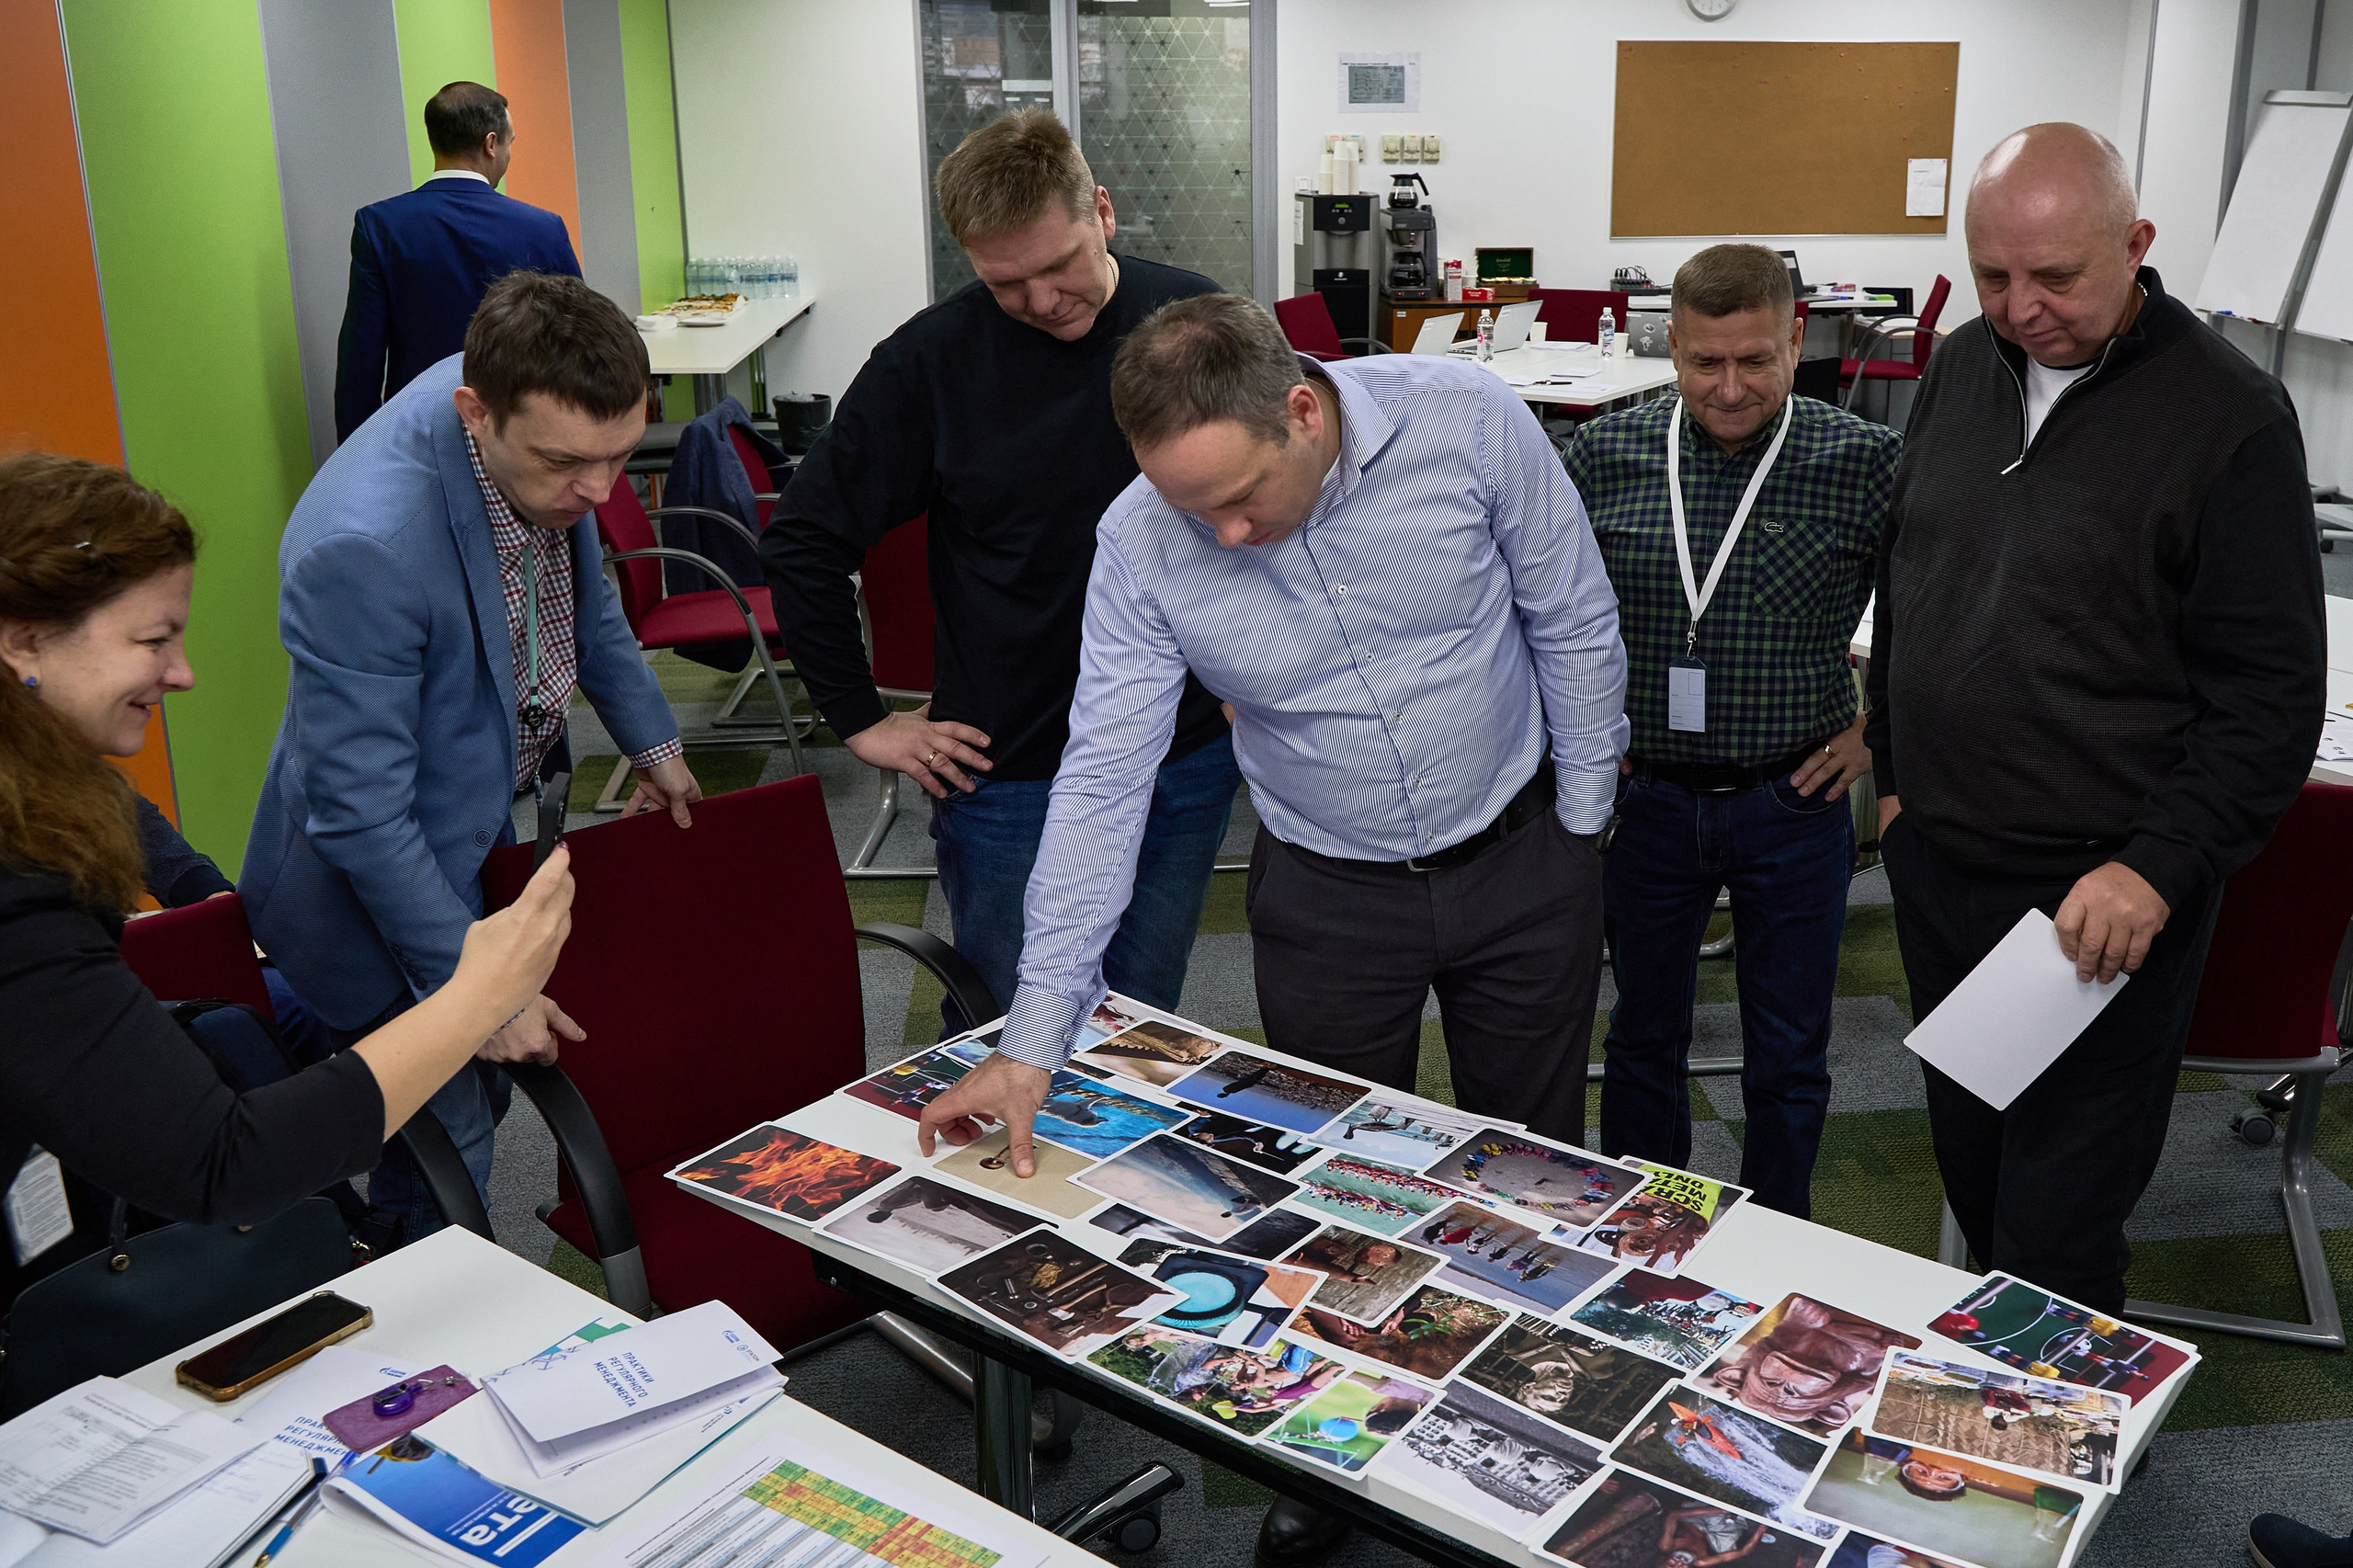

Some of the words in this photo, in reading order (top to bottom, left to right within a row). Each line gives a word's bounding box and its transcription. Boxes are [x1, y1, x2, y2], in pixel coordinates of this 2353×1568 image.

[1649, 1177, 1707, 1202] META
[1654, 1171, 1704, 1189] ONLY
[1640, 1185, 1703, 1211] SCRA
[607, 1356, 648, 1398] РЕГУЛЯРНОГО
[621, 1351, 655, 1383] ПРАКТИКИ
[593, 1361, 637, 1407] МЕНЕДЖМЕНТА
[284, 1425, 344, 1445] РЕГУЛЯРН
[294, 1416, 329, 1430] ПРАК
[273, 1434, 347, 1456] МЕНЕДЖМЕ
[459, 1494, 540, 1546] ета
